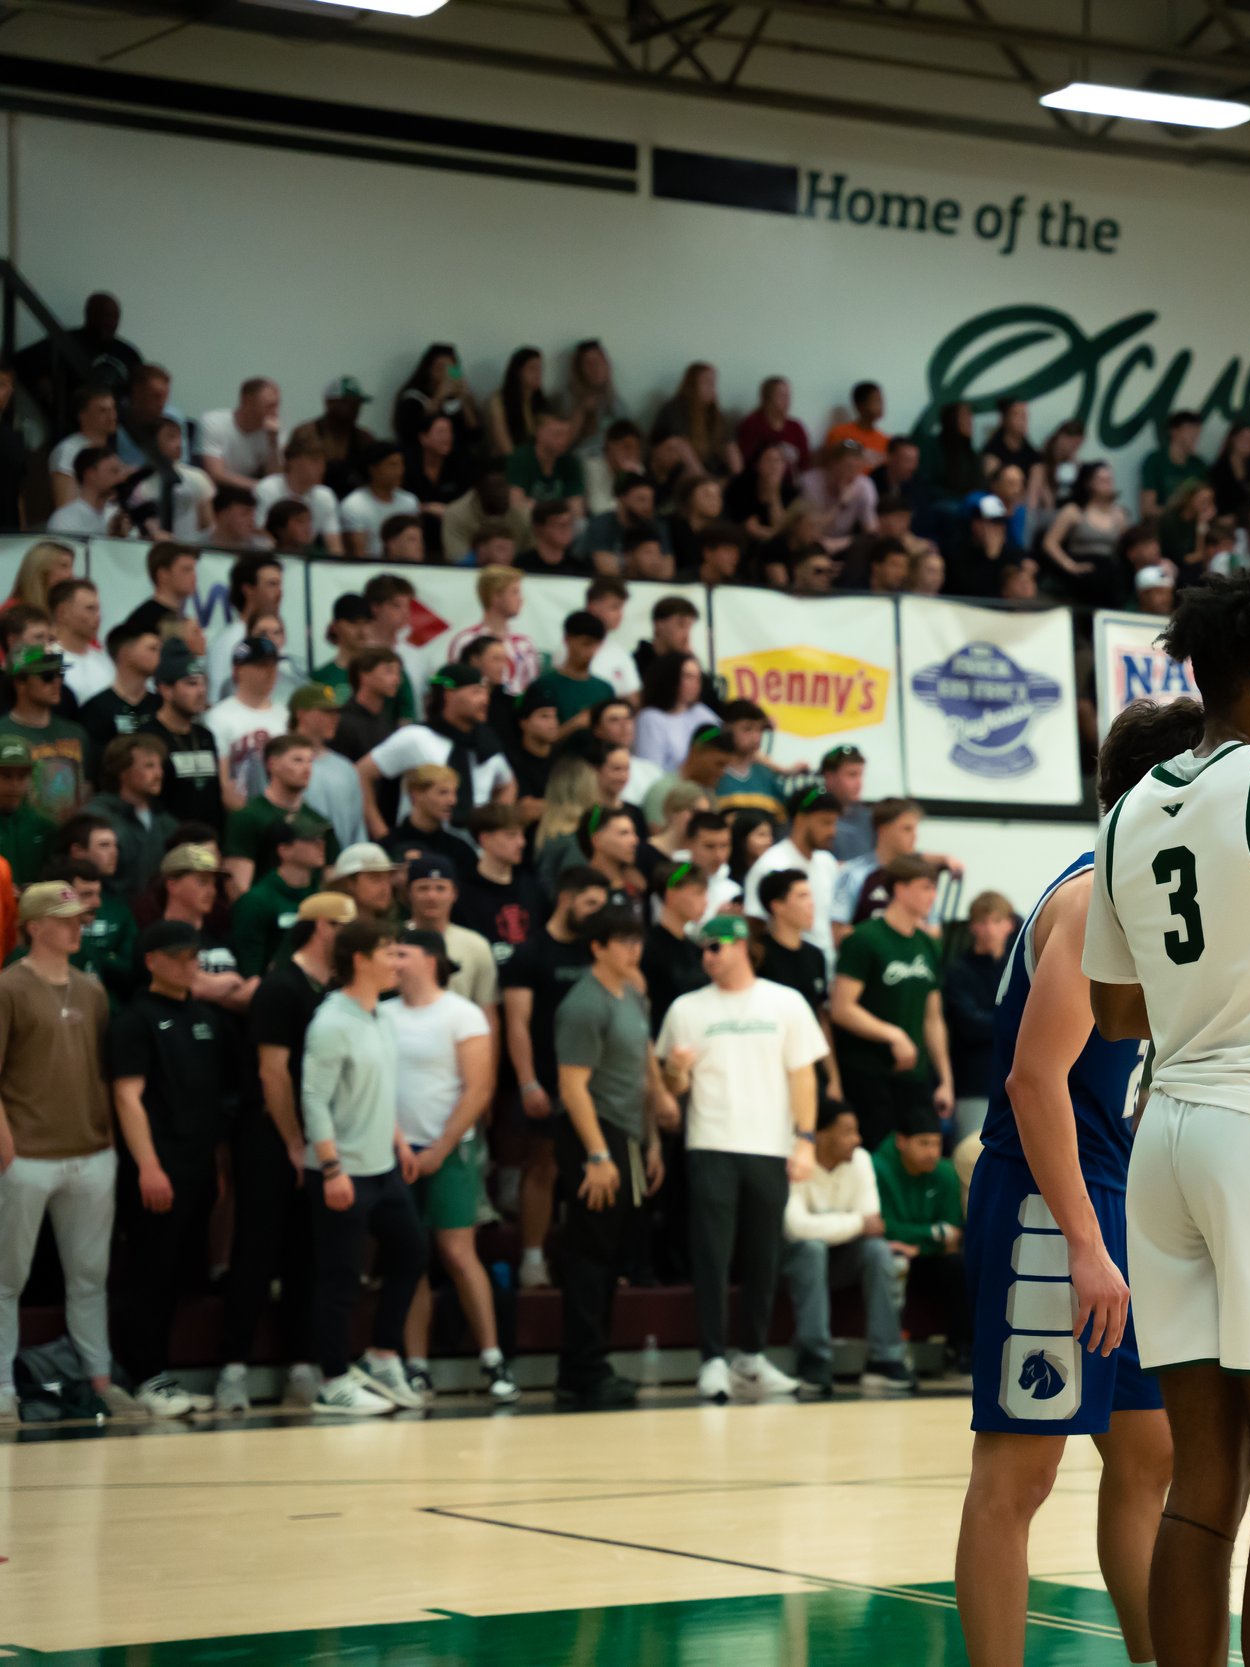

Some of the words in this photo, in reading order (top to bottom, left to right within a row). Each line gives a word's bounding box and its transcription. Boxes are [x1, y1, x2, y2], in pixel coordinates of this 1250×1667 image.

[804, 169, 962, 235] Home
[973, 194, 1026, 256] of
[1039, 199, 1120, 254] the
[733, 663, 877, 716] Denny's
[1152, 845, 1205, 965] 3
